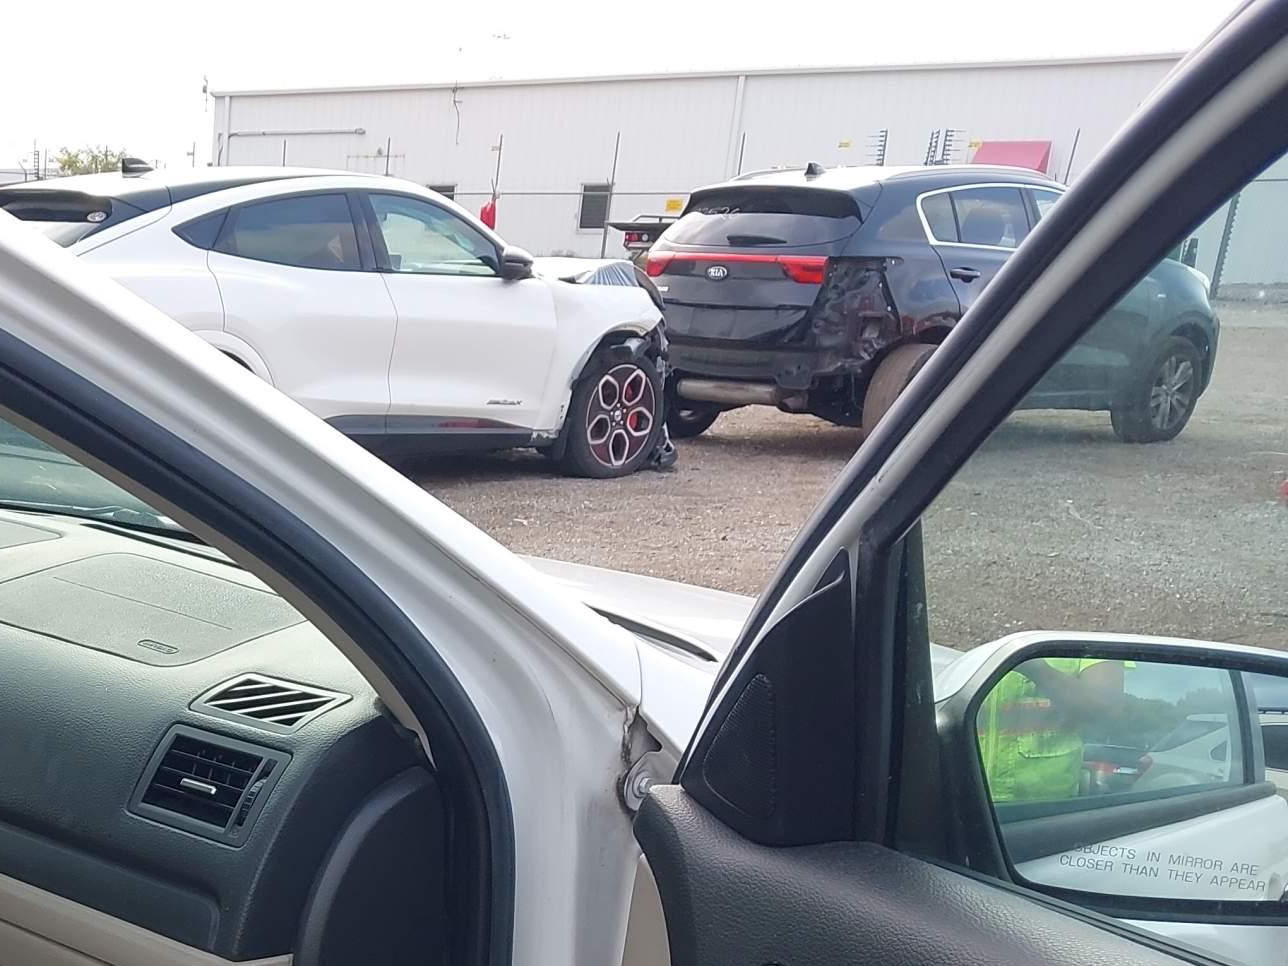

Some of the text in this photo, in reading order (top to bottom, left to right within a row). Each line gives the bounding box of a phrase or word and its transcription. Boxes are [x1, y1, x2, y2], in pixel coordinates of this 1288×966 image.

[1059, 854, 1266, 892] CLOSER THAN THEY APPEAR
[1146, 851, 1161, 863] IN
[1168, 854, 1223, 872] MIRROR
[1230, 862, 1261, 876] ARE
